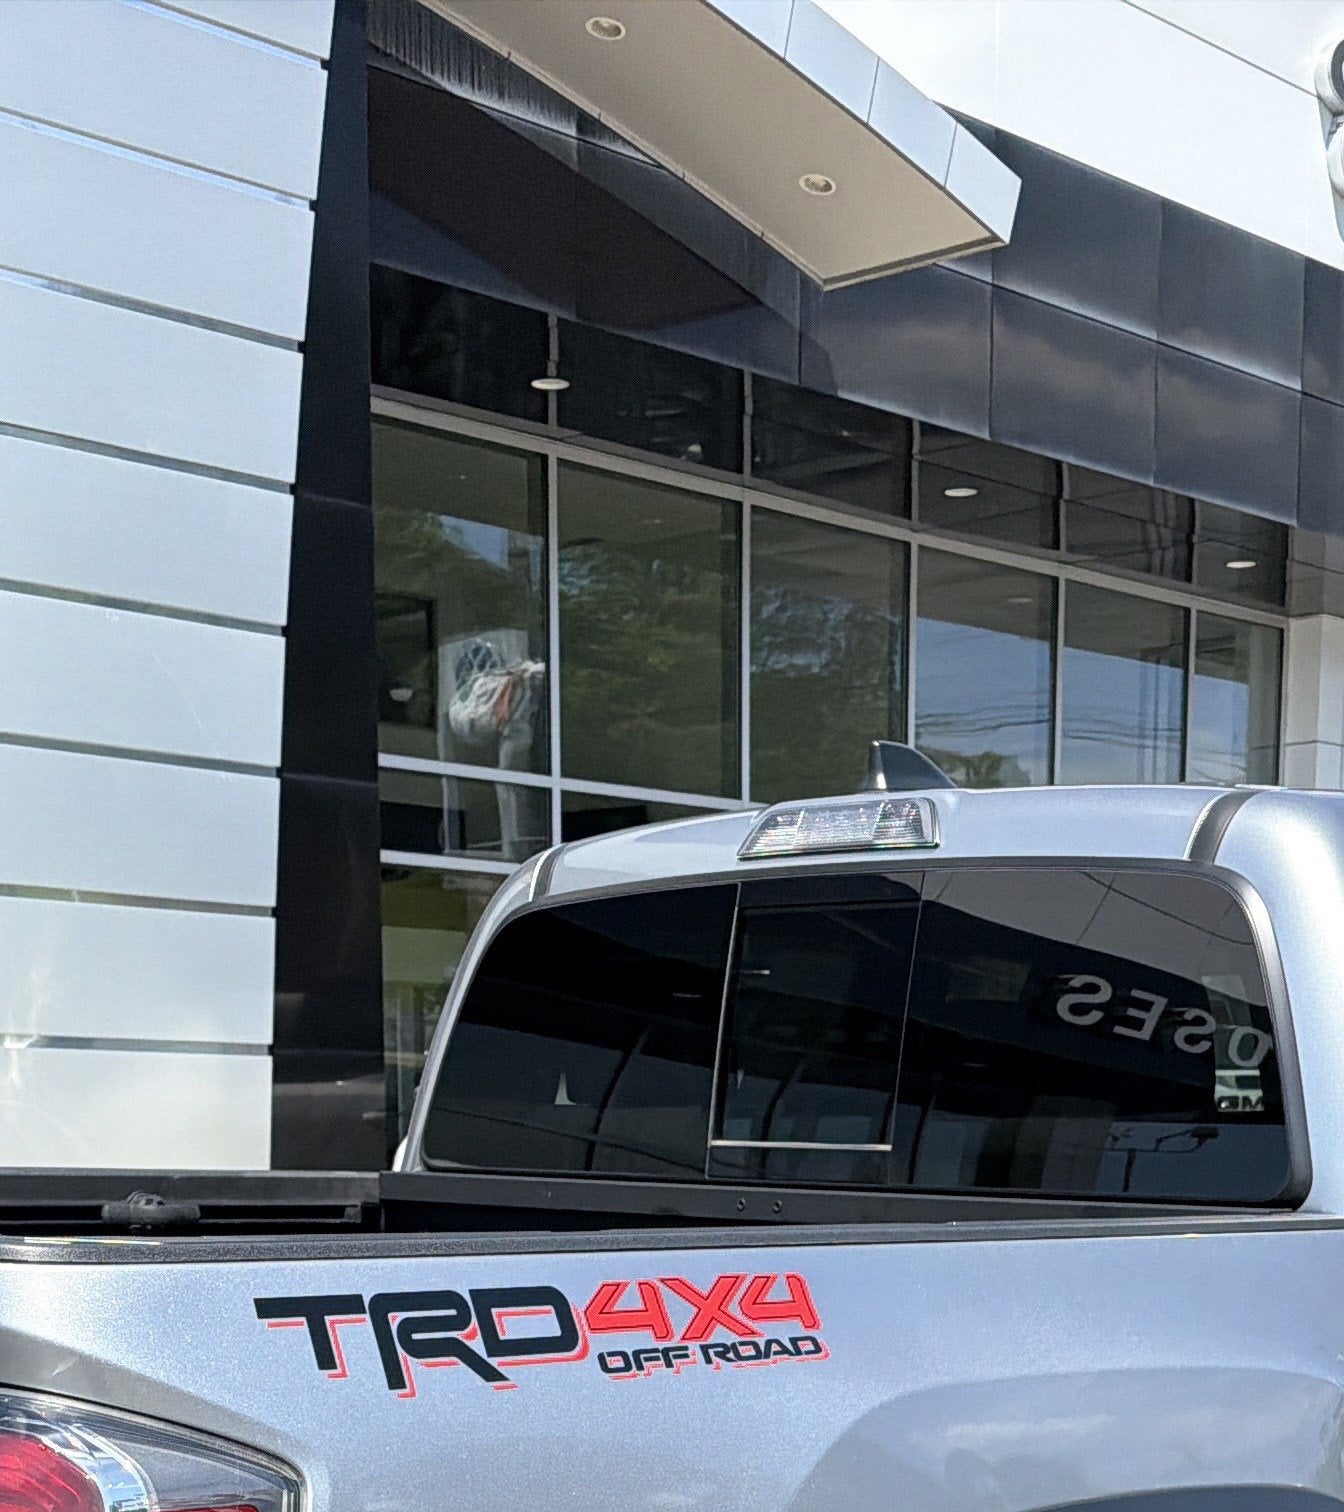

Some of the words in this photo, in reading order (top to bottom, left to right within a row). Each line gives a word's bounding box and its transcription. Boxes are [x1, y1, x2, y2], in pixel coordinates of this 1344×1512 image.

[253, 1284, 592, 1398] TRD
[597, 1344, 698, 1381] OFF
[700, 1335, 830, 1376] ROAD
